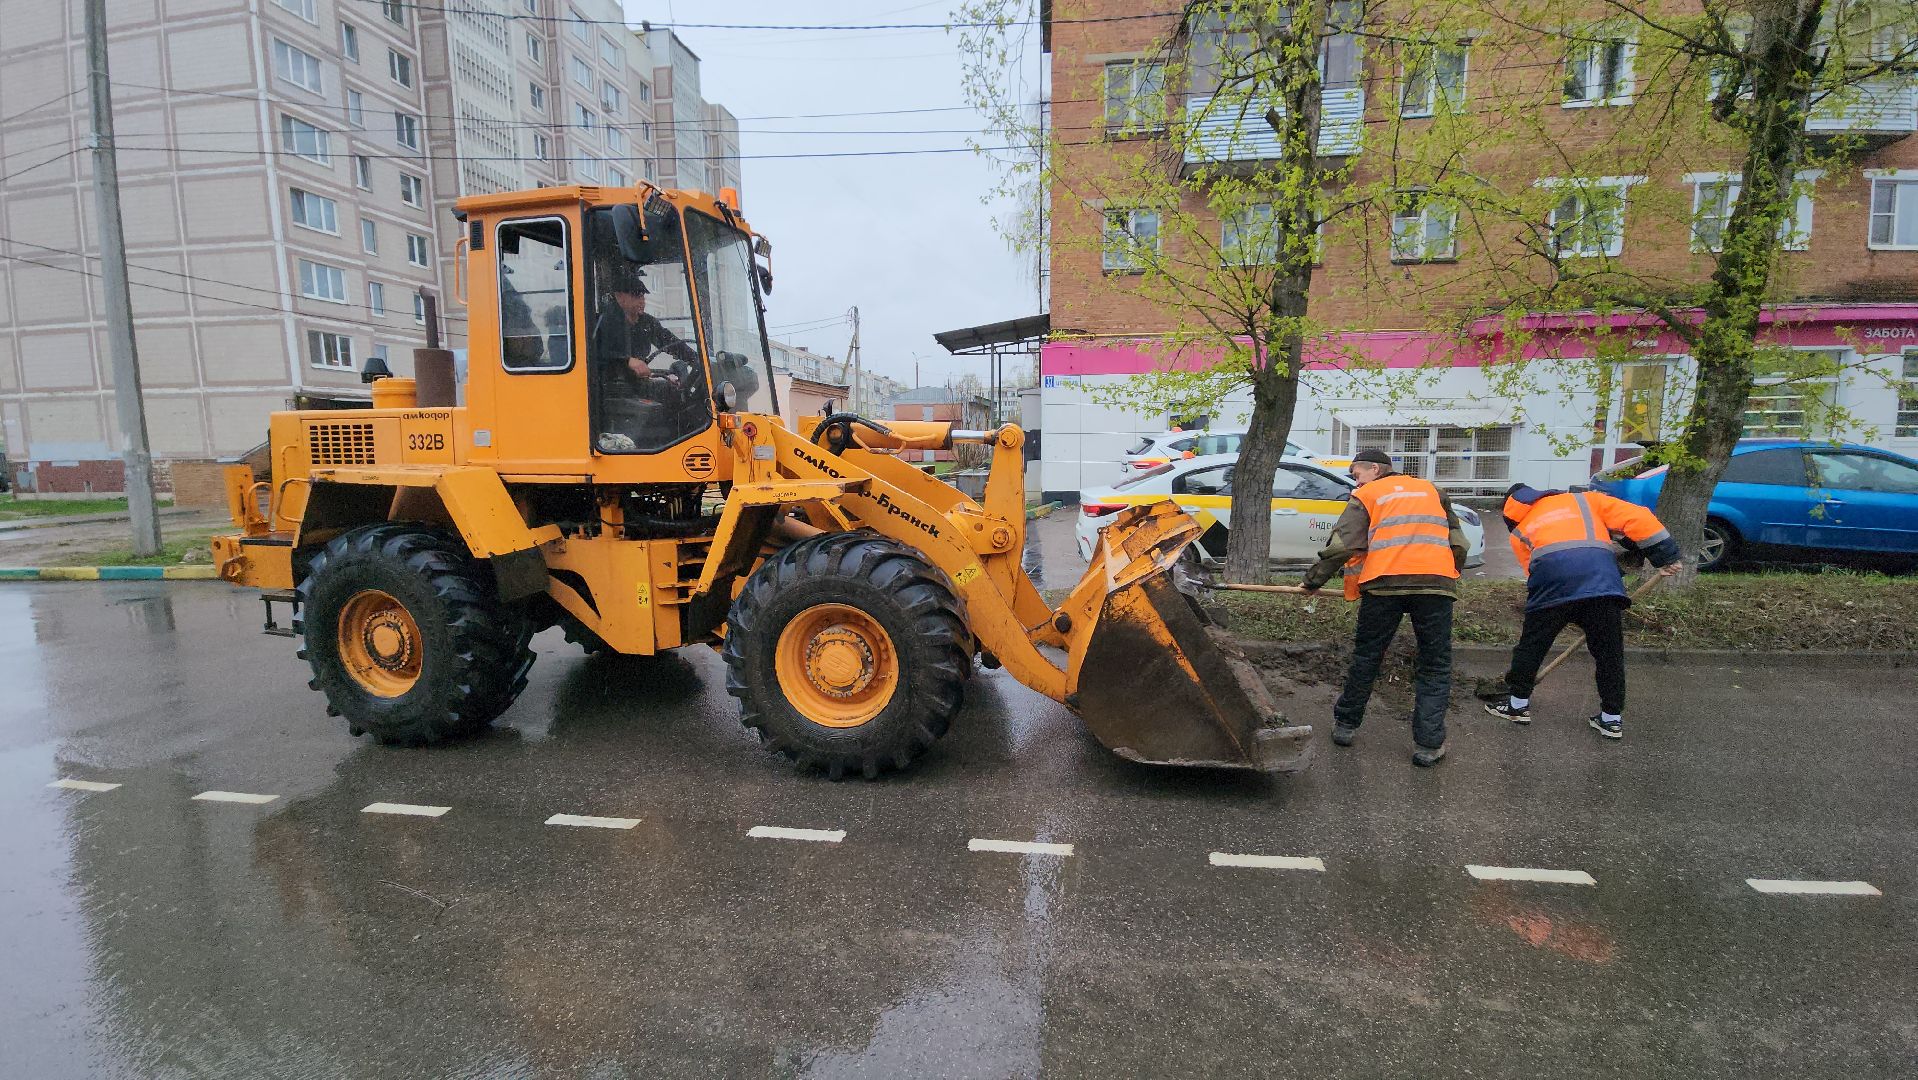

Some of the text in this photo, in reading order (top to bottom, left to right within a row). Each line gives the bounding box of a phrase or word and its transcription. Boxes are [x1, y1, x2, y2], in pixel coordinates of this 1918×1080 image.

[1864, 327, 1915, 339] ЗАБОТА
[402, 410, 450, 421] амкодор
[1308, 517, 1338, 531] Яндек
